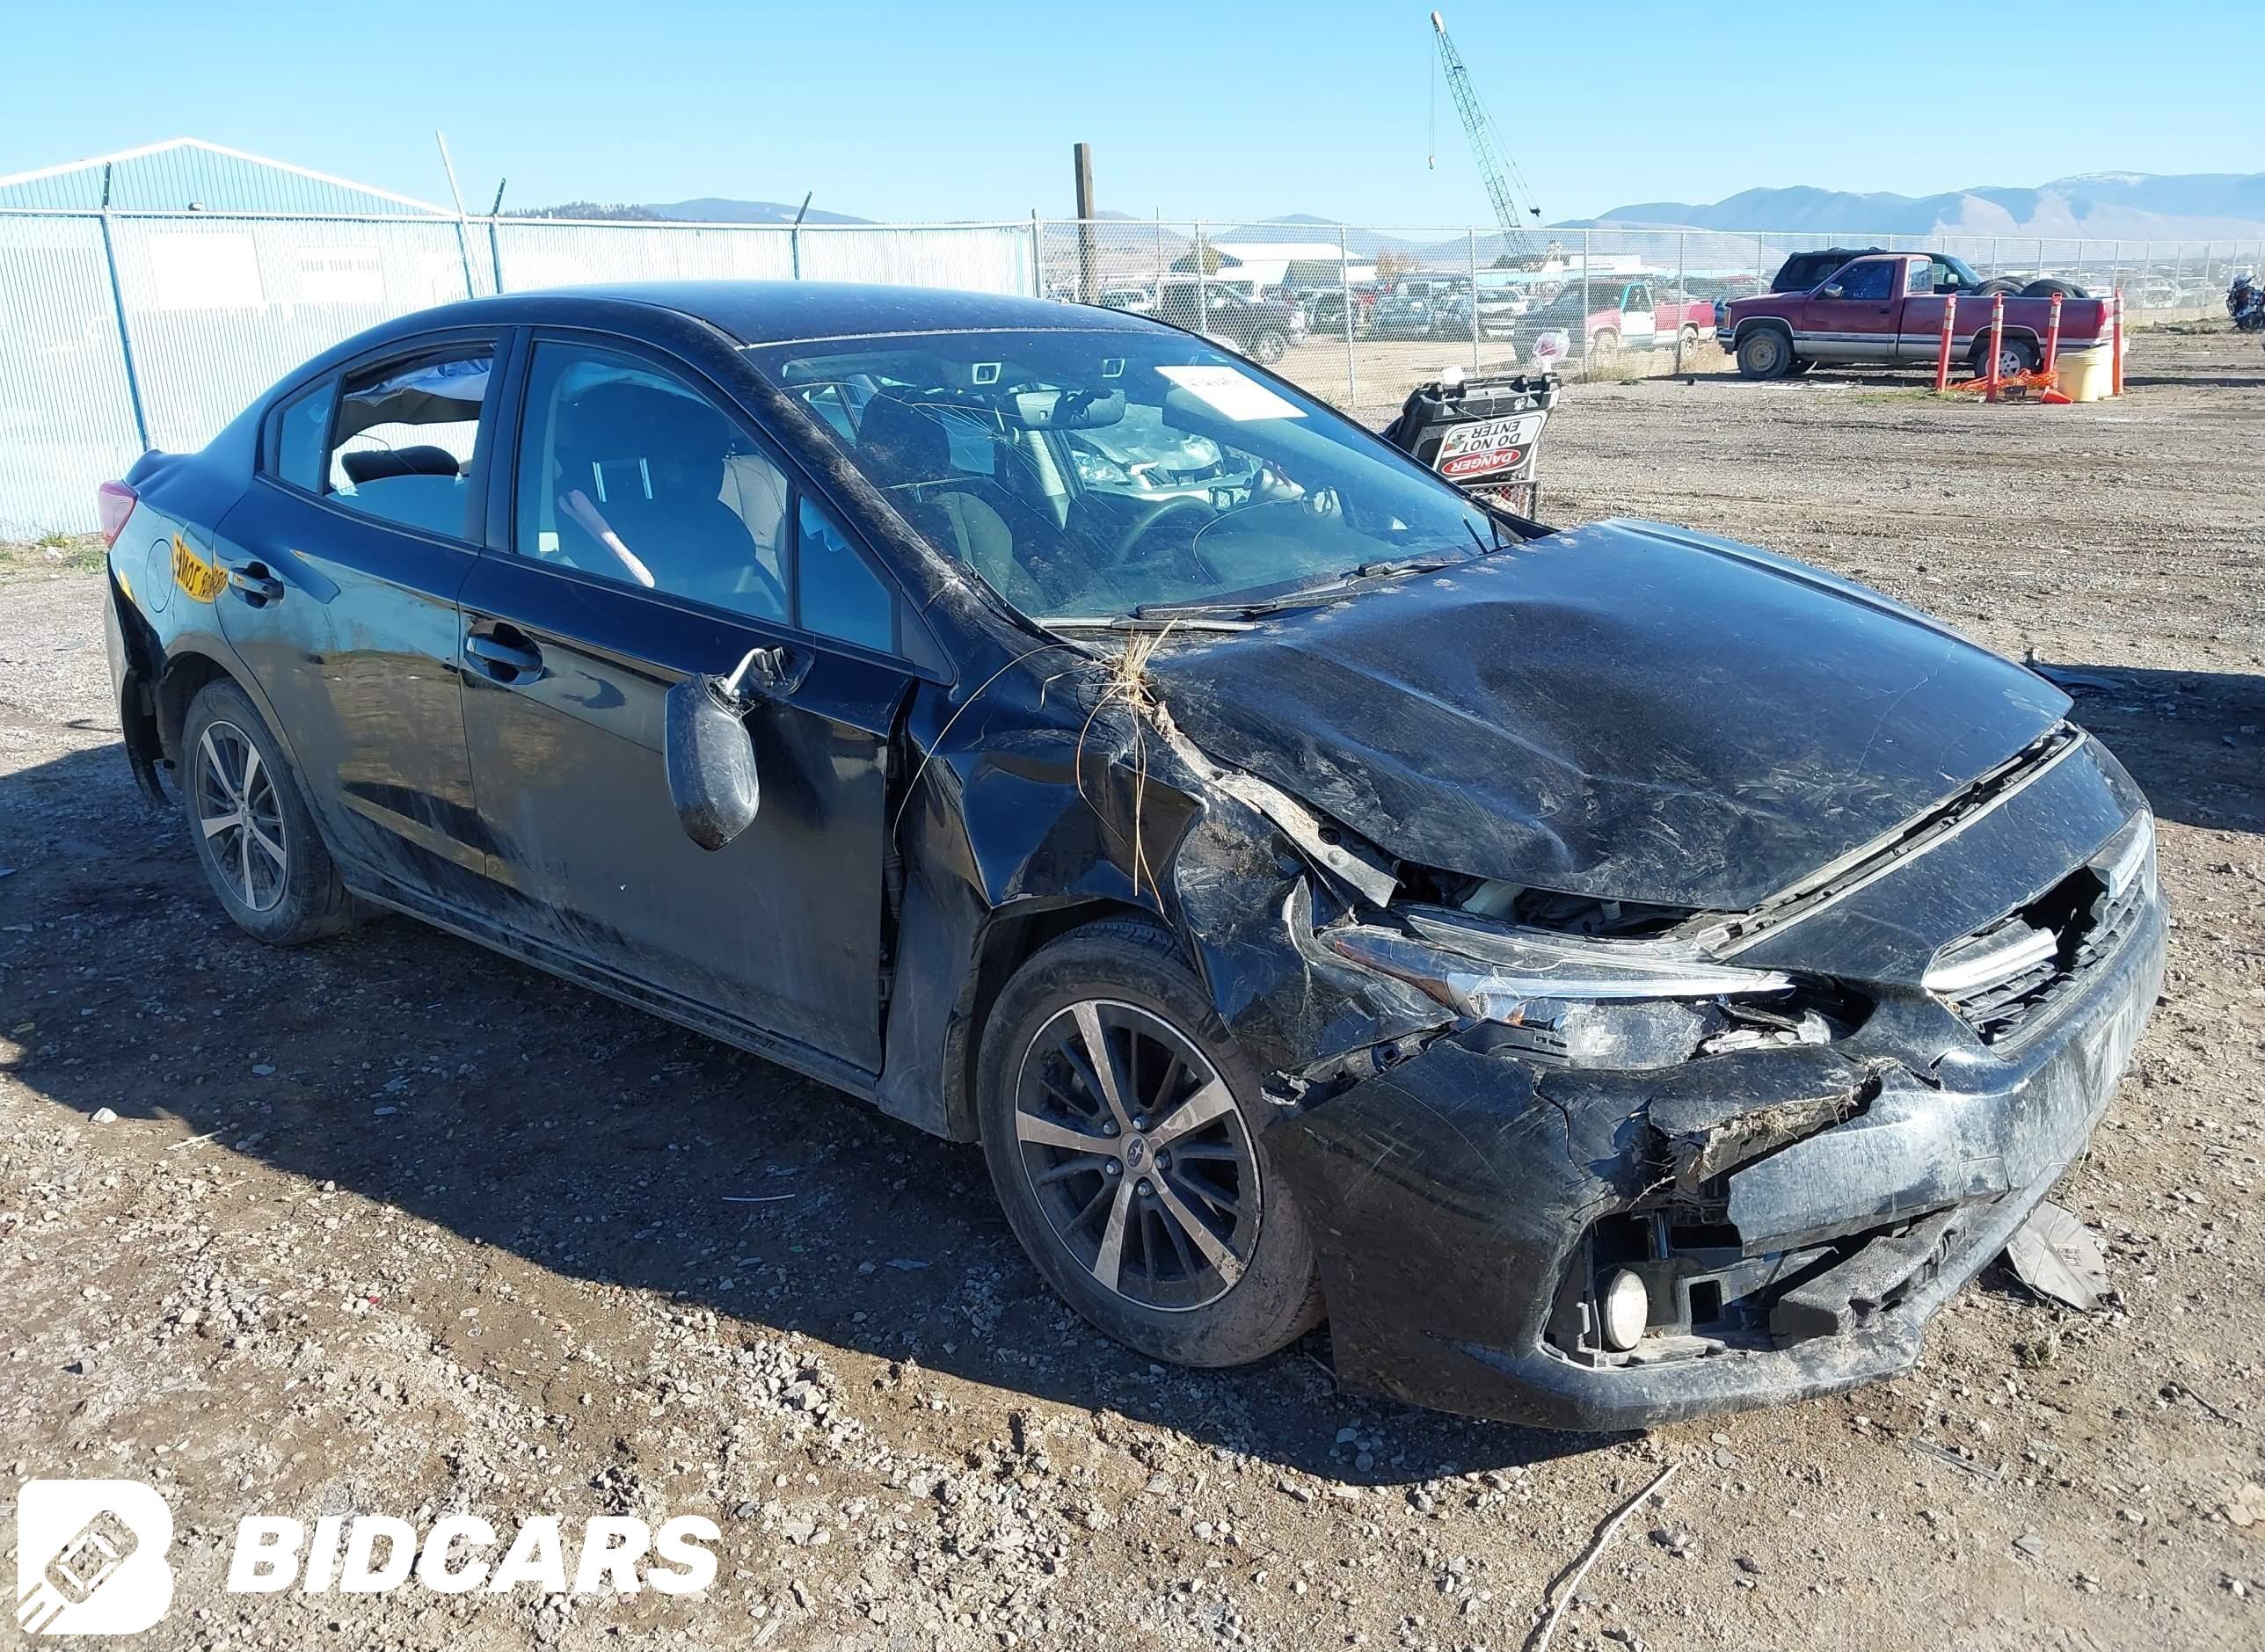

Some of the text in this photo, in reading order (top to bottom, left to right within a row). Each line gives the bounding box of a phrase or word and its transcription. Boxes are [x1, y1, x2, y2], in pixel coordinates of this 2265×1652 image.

[1471, 420, 1521, 439] ENTER
[1460, 433, 1521, 454] DO NOT
[1450, 452, 1514, 472] DANGER
